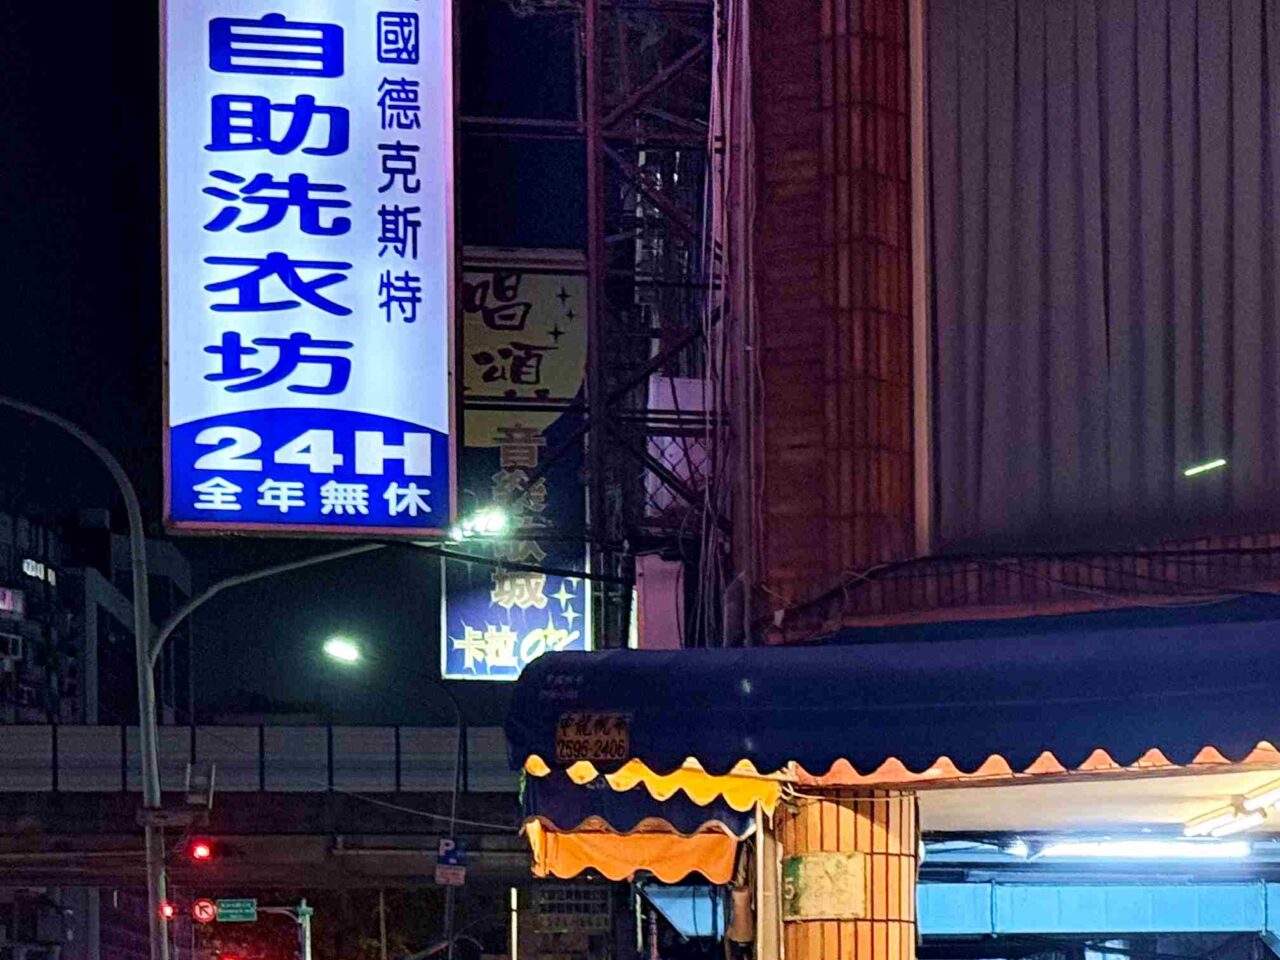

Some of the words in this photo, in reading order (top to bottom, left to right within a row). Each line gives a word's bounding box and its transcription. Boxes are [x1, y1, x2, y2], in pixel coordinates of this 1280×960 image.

[202, 12, 354, 396] 自助洗衣坊
[376, 11, 423, 324] 國德克斯特
[193, 427, 432, 475] 24H
[193, 477, 432, 517] 全年無休
